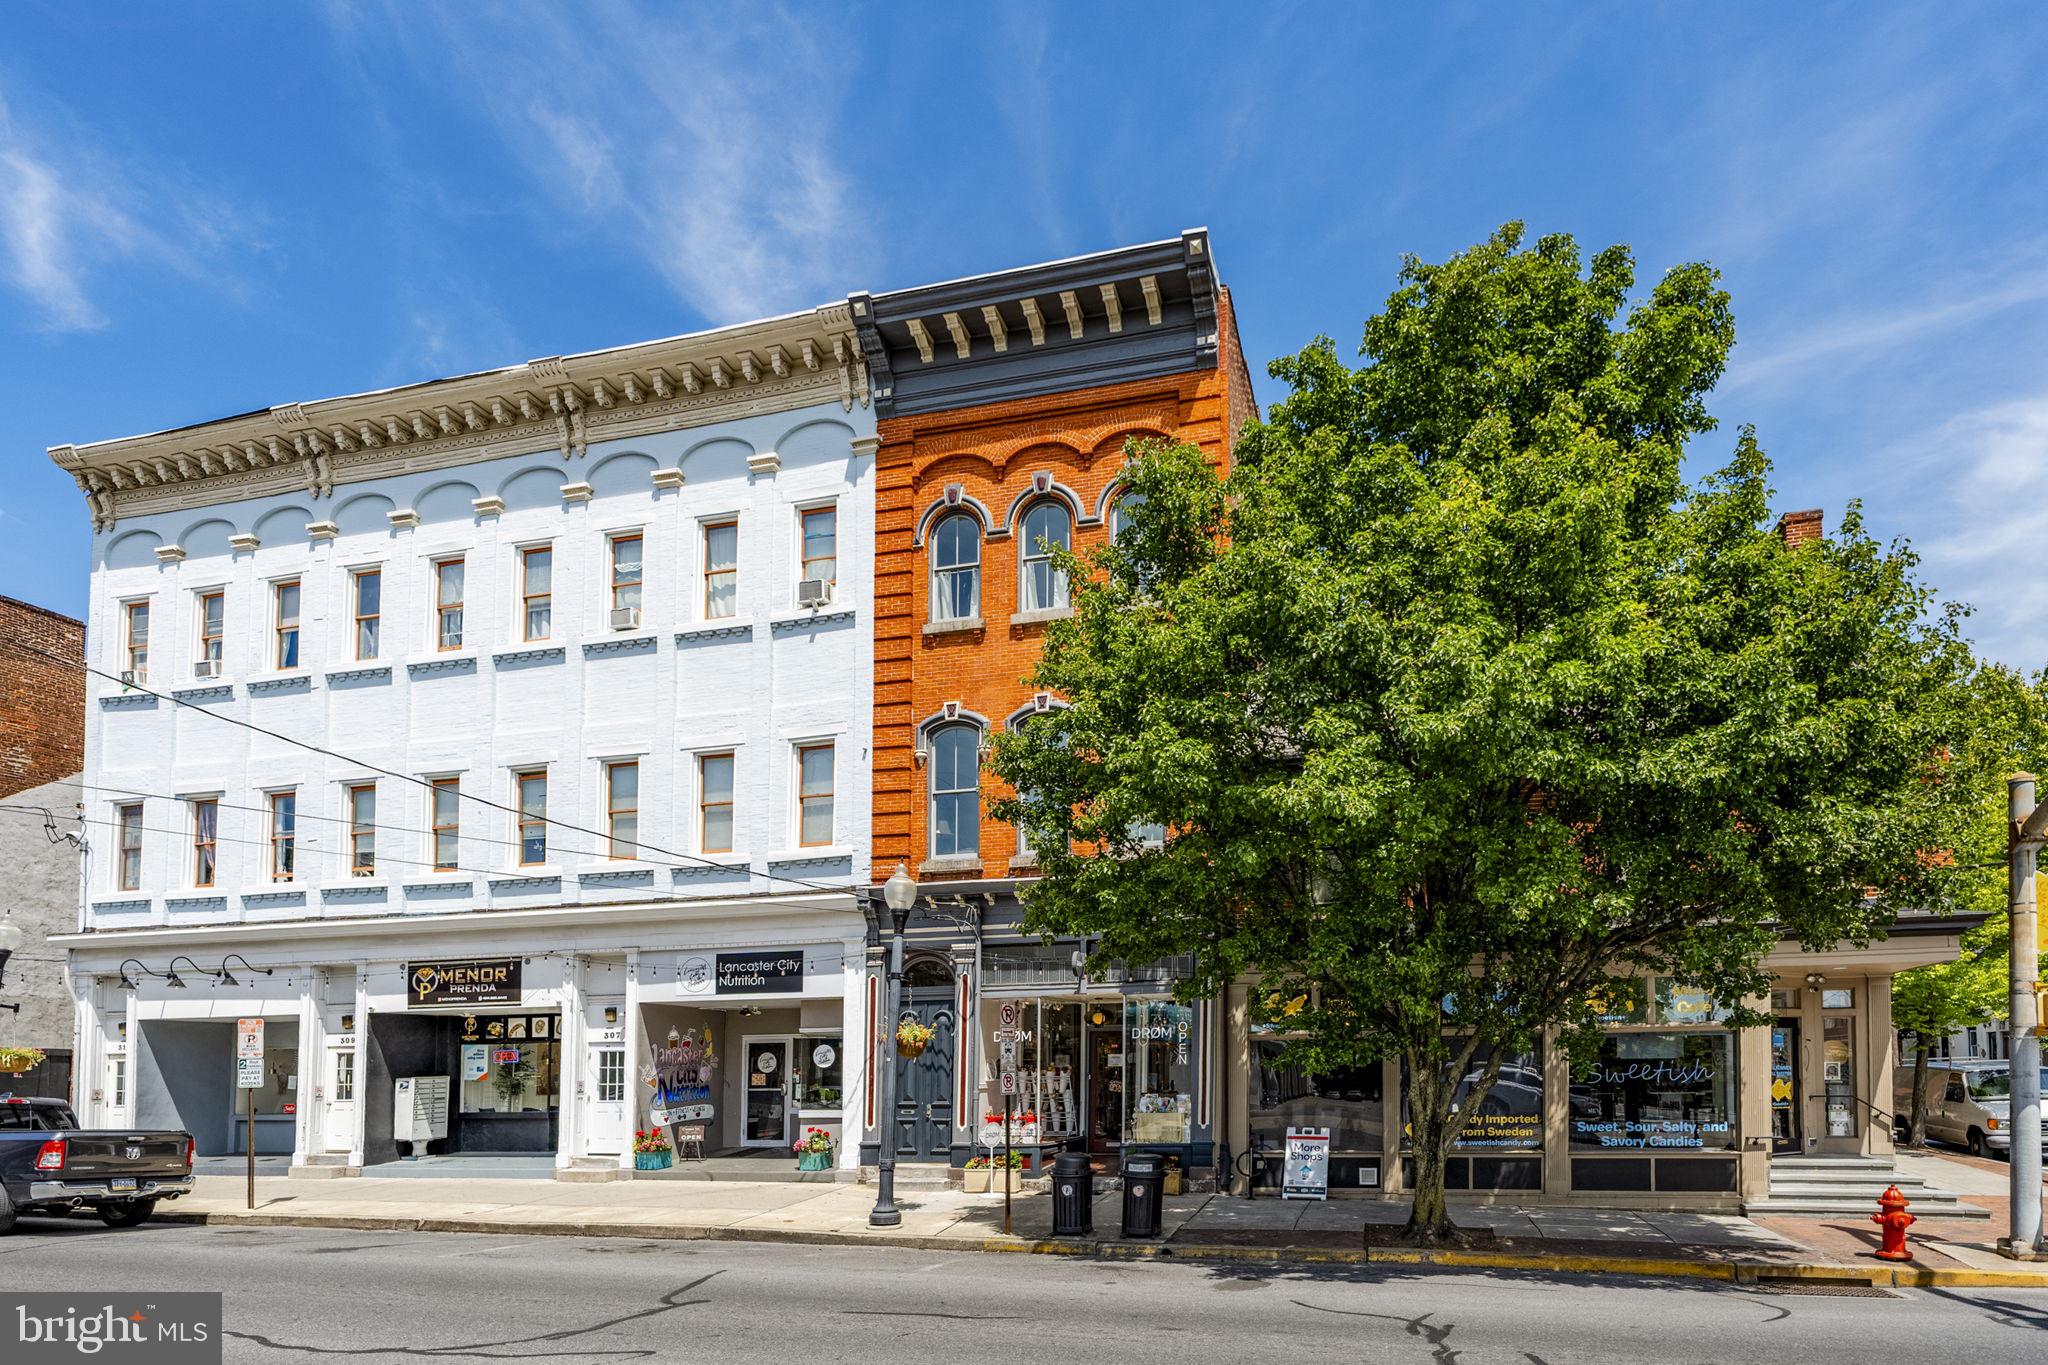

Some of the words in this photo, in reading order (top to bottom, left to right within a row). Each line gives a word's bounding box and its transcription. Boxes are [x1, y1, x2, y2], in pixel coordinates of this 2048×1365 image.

[719, 961, 774, 973] Lancaster
[777, 959, 800, 971] City
[440, 967, 507, 983] MENOR
[719, 975, 765, 987] Nutrition
[449, 984, 496, 993] PRENDA
[604, 1031, 620, 1039] 307
[1131, 1026, 1172, 1039] DRØM
[1178, 1021, 1188, 1065] OPEN
[494, 1051, 517, 1062] OPEN
[652, 1043, 703, 1064] Lancaster
[240, 1060, 246, 1069] 2
[1586, 1058, 1716, 1084] Sweetish
[1486, 1114, 1538, 1126] Imported
[1459, 1128, 1484, 1136] rom
[1488, 1127, 1533, 1136] Sweden
[1577, 1121, 1622, 1133] Sweet,
[1626, 1121, 1660, 1133] Sour,
[1662, 1121, 1700, 1135] Salty,
[1702, 1121, 1728, 1132] and
[1294, 1143, 1320, 1152] More
[1601, 1136, 1646, 1148] Savory
[1650, 1136, 1703, 1147] Candies
[1291, 1152, 1323, 1162] Shops
